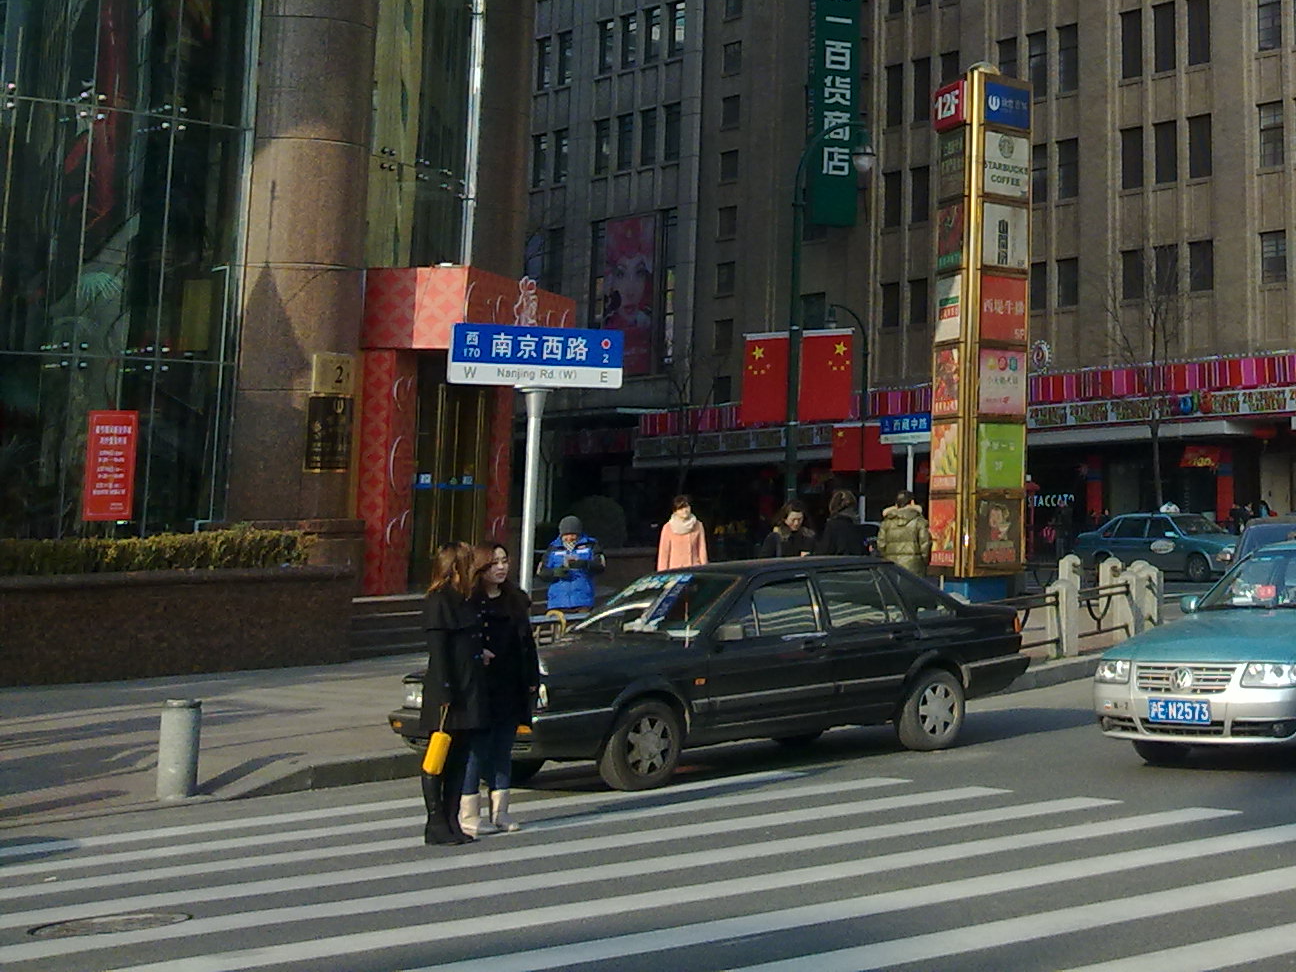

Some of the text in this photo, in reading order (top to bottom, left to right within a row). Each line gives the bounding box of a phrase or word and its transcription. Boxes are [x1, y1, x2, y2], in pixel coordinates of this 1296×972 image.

[934, 89, 960, 120] 12F
[984, 159, 1028, 177] STARBUCKS
[990, 174, 1021, 188] COFFEE
[463, 347, 481, 358] 170
[466, 331, 589, 362] 西 南京西路
[463, 366, 477, 379] W
[497, 368, 536, 381] Nanjing
[558, 369, 577, 380] (W)
[600, 371, 608, 383] E
